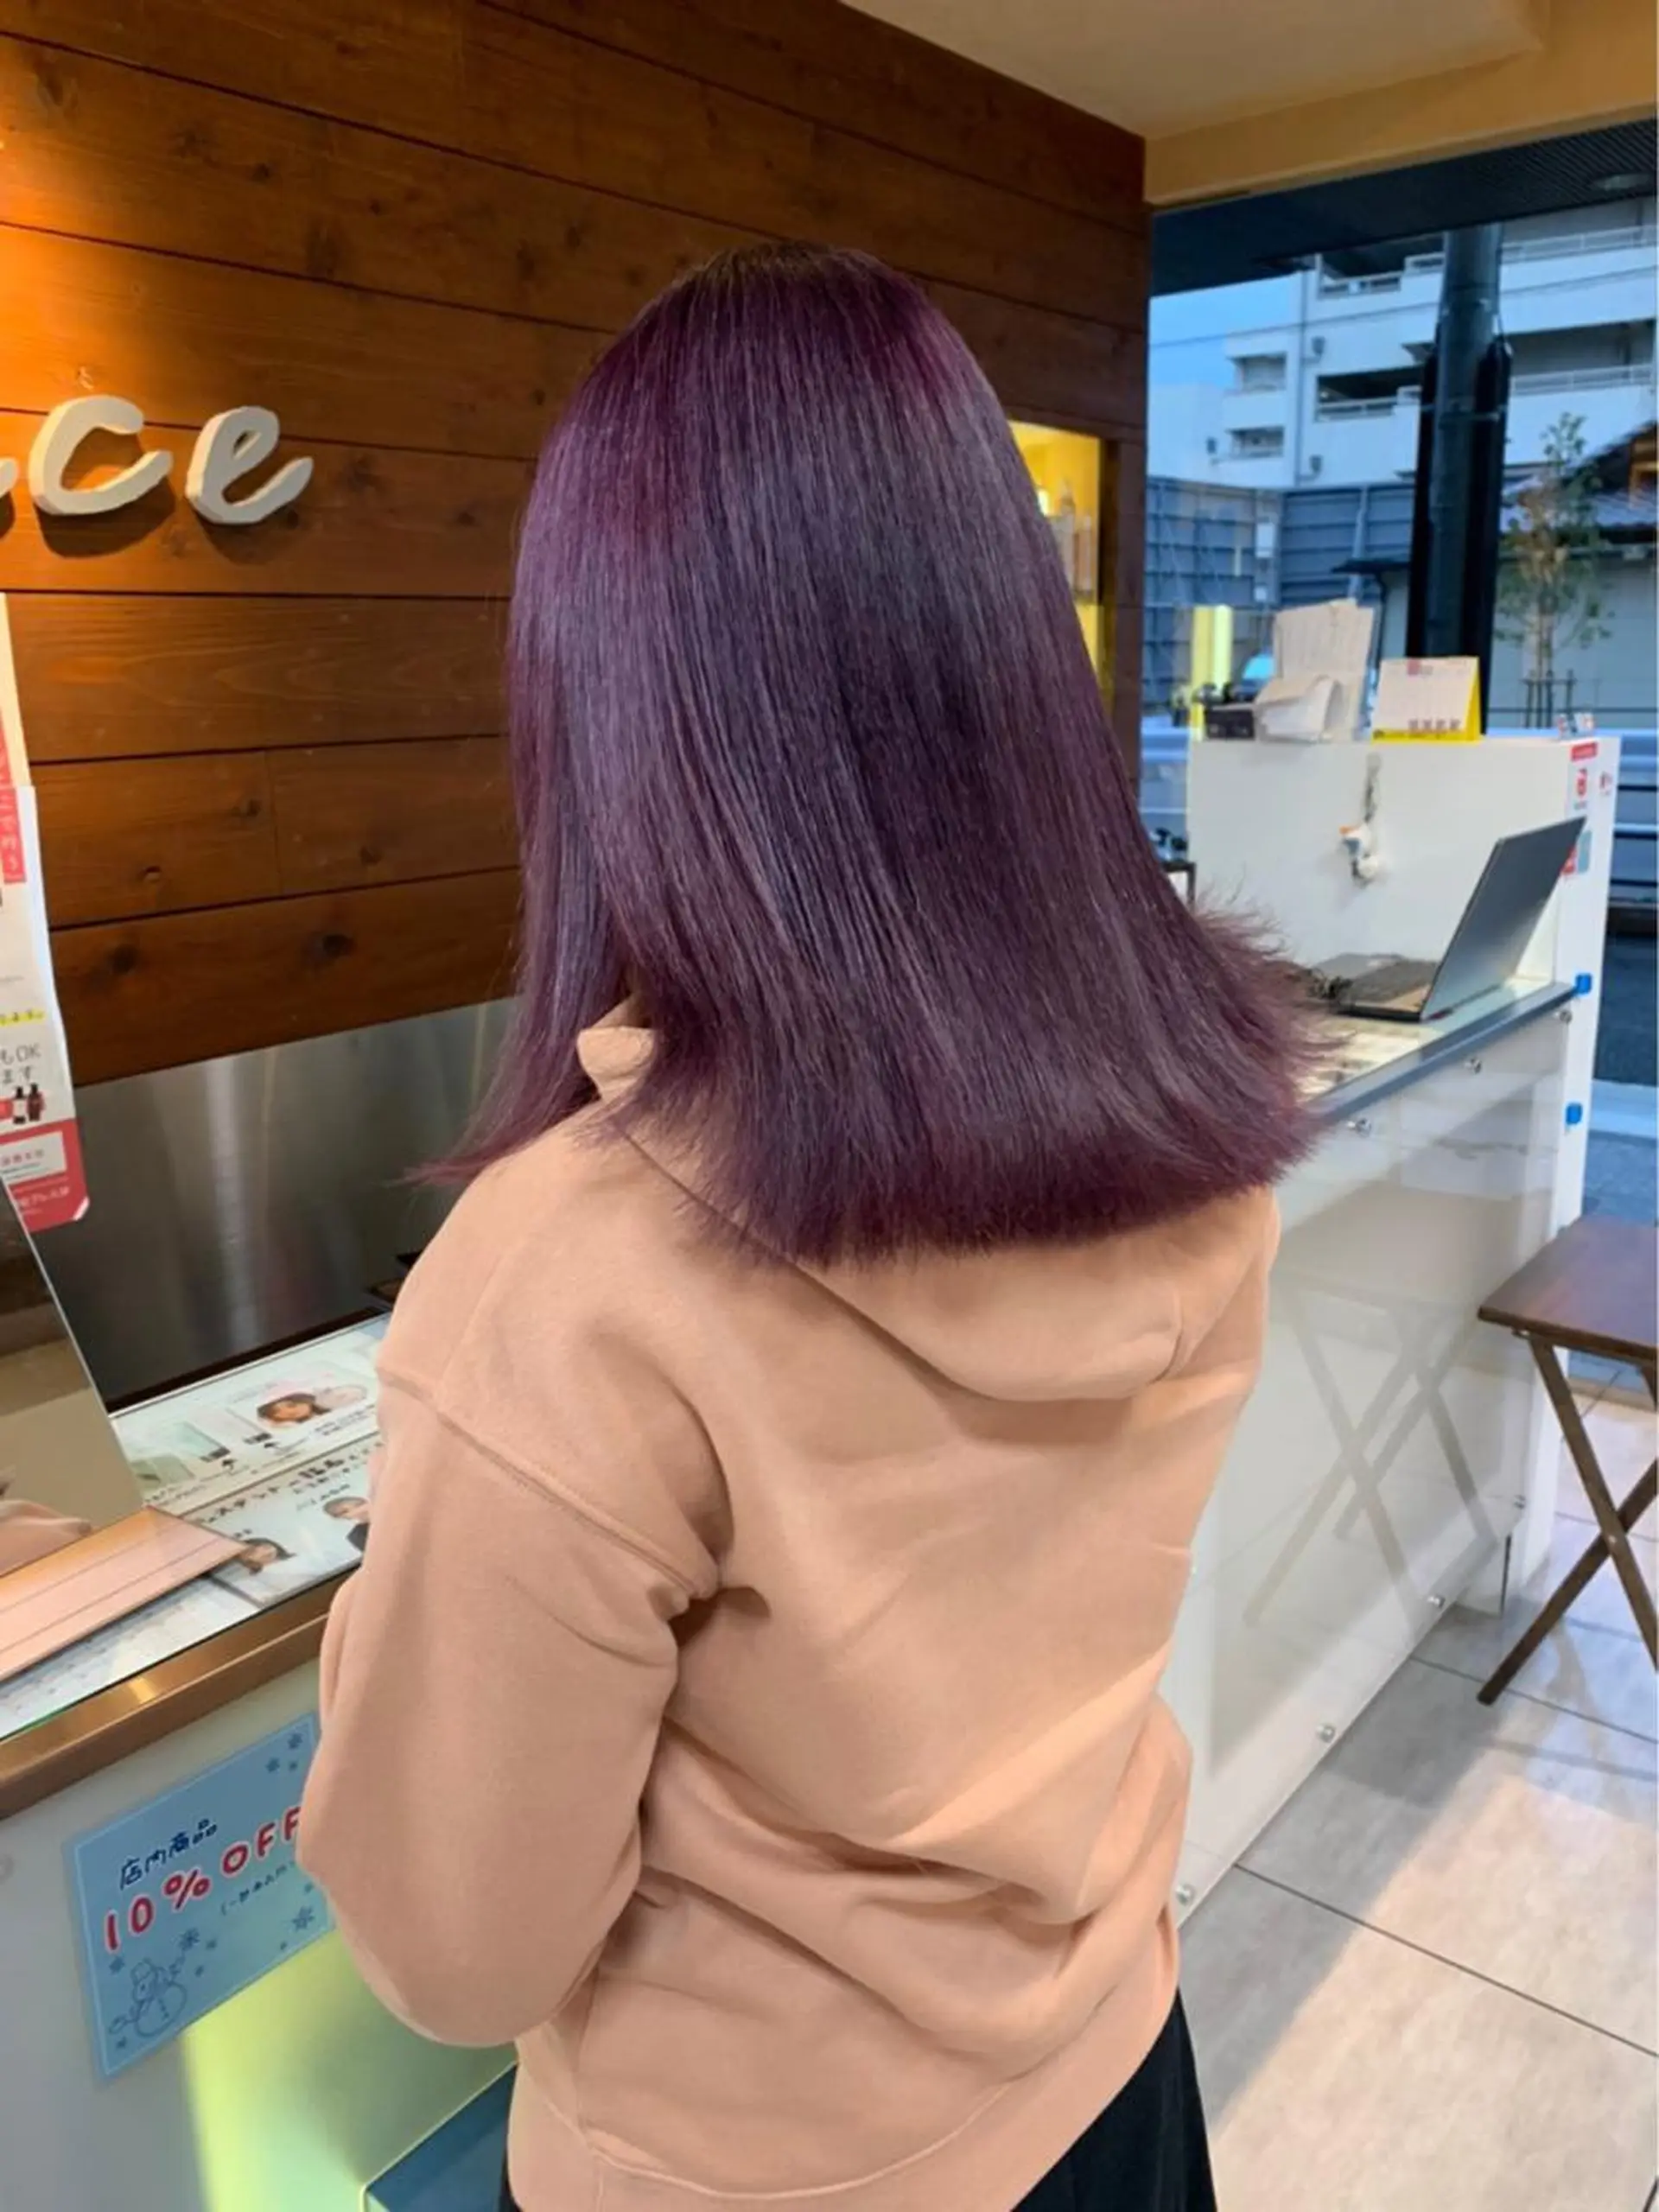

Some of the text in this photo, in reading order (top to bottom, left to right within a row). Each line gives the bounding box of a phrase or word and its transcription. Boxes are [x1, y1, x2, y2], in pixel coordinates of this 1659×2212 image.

[0, 395, 314, 525] ce
[119, 1817, 218, 1891] 店内商品
